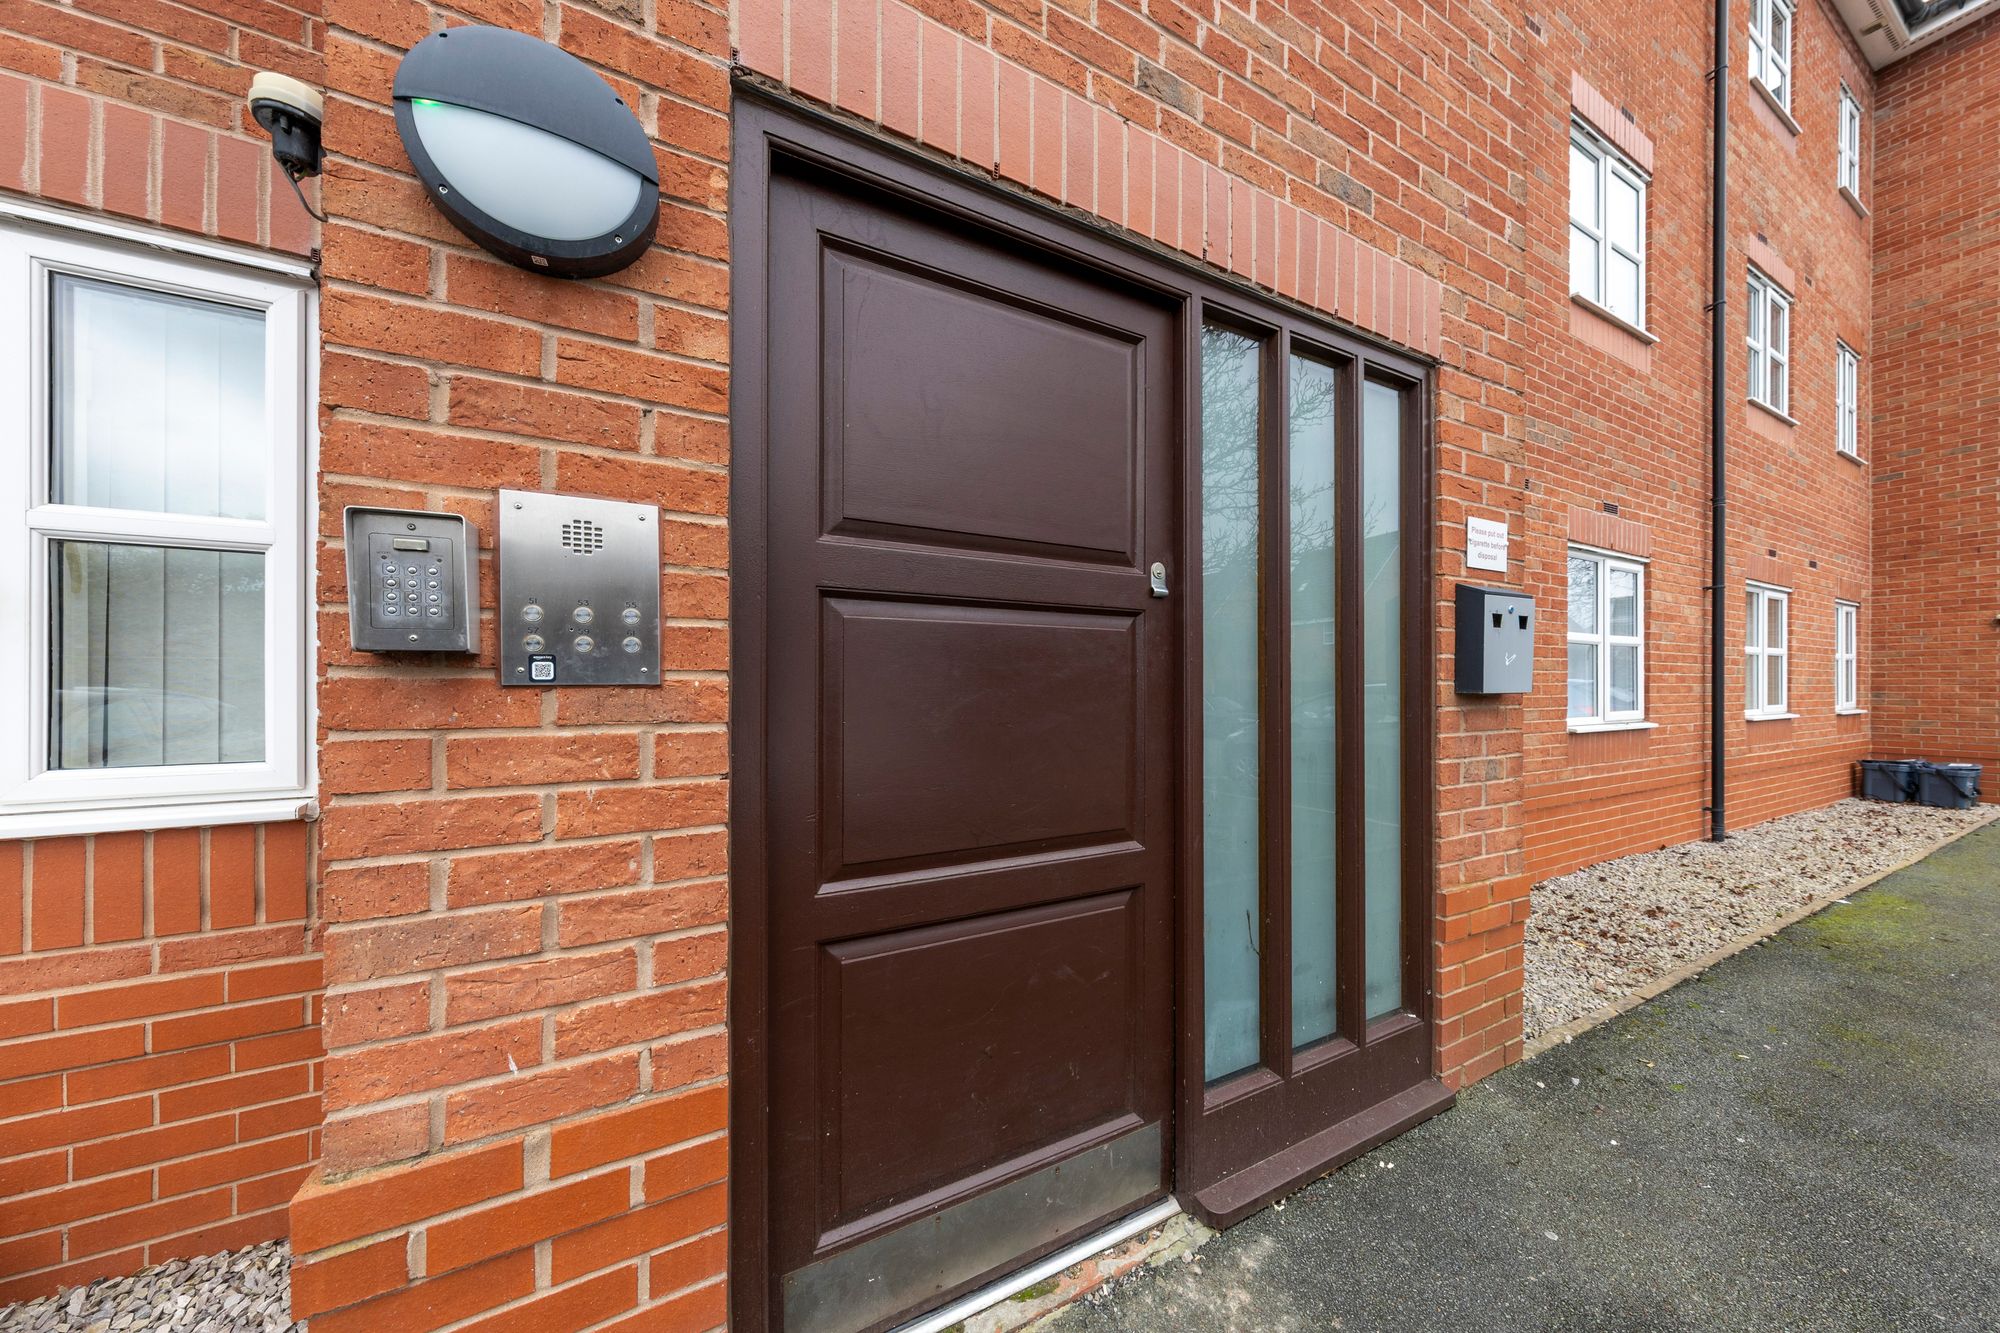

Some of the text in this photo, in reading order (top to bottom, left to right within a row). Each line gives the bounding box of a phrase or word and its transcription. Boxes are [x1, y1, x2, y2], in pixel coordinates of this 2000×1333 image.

[1472, 526, 1487, 535] Please
[1478, 552, 1497, 560] disposal
[527, 626, 539, 634] 57
